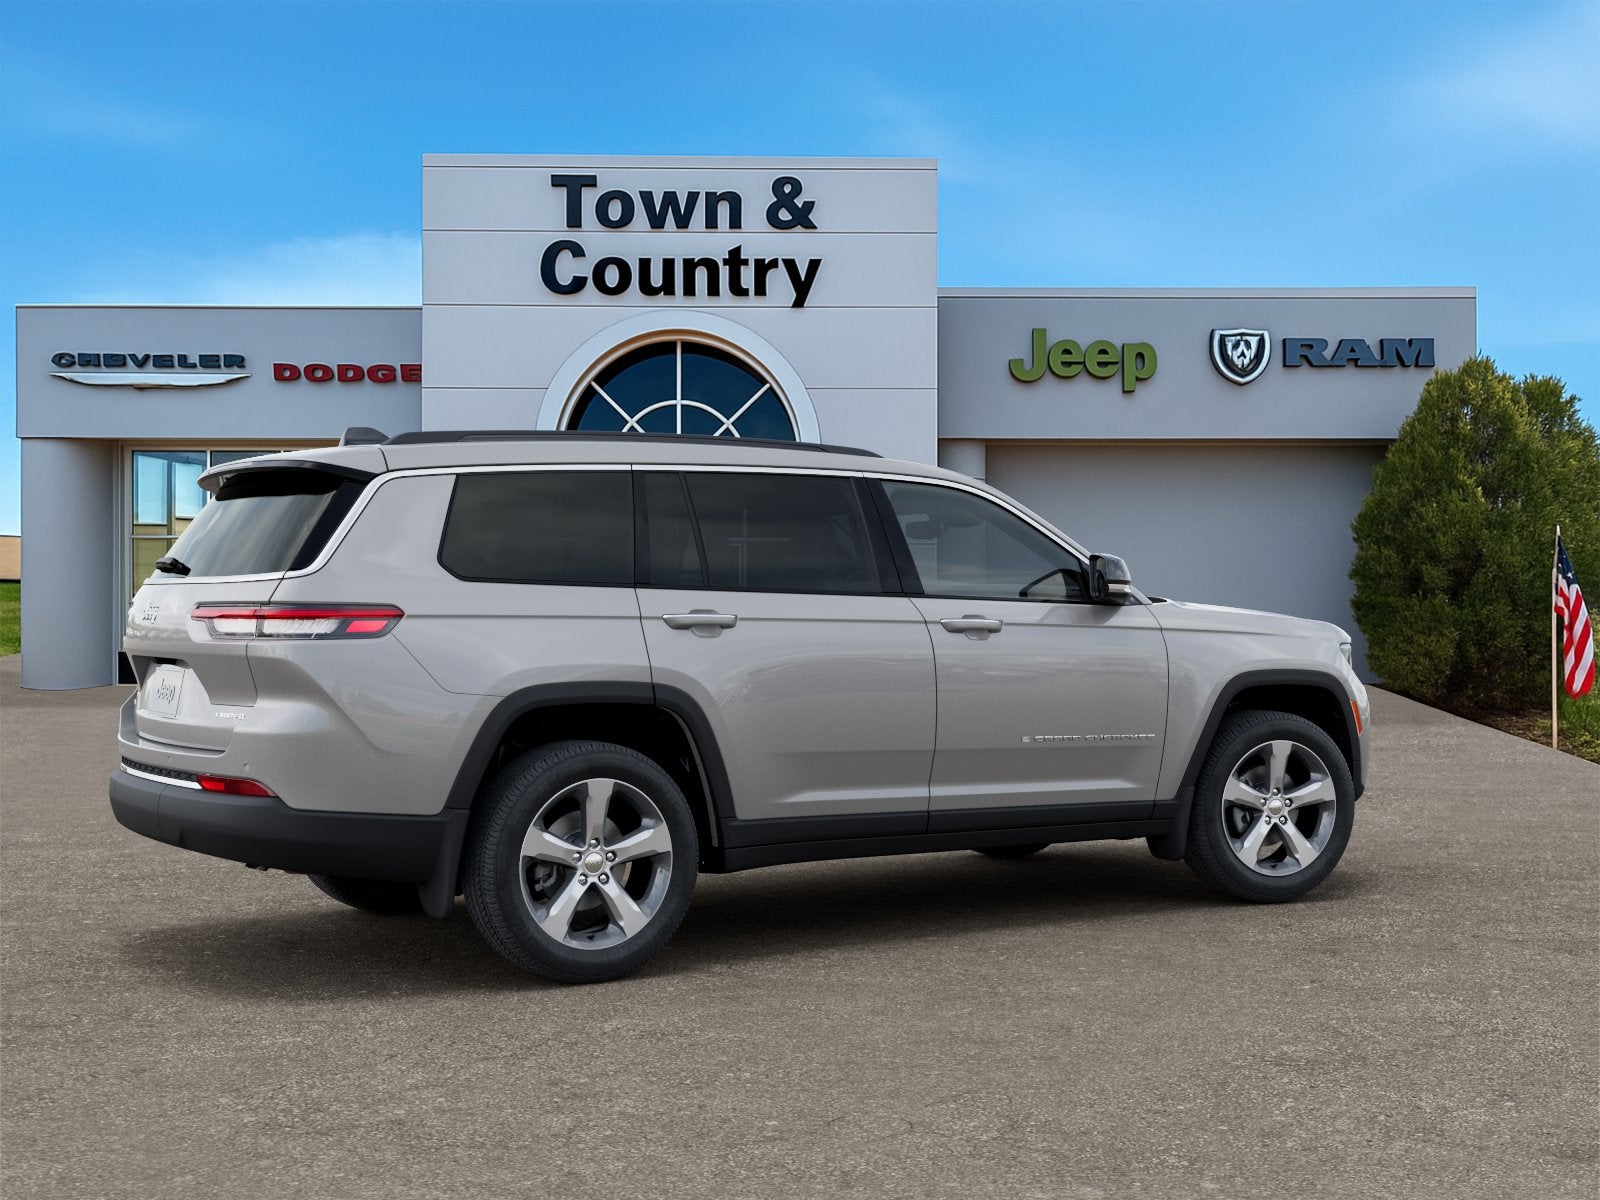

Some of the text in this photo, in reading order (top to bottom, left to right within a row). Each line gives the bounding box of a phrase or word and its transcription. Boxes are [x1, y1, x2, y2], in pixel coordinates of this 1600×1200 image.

[550, 174, 818, 230] Town &
[539, 239, 823, 308] Country
[272, 362, 422, 383] DODGE
[1008, 327, 1158, 393] Jeep
[1282, 337, 1436, 368] RAM
